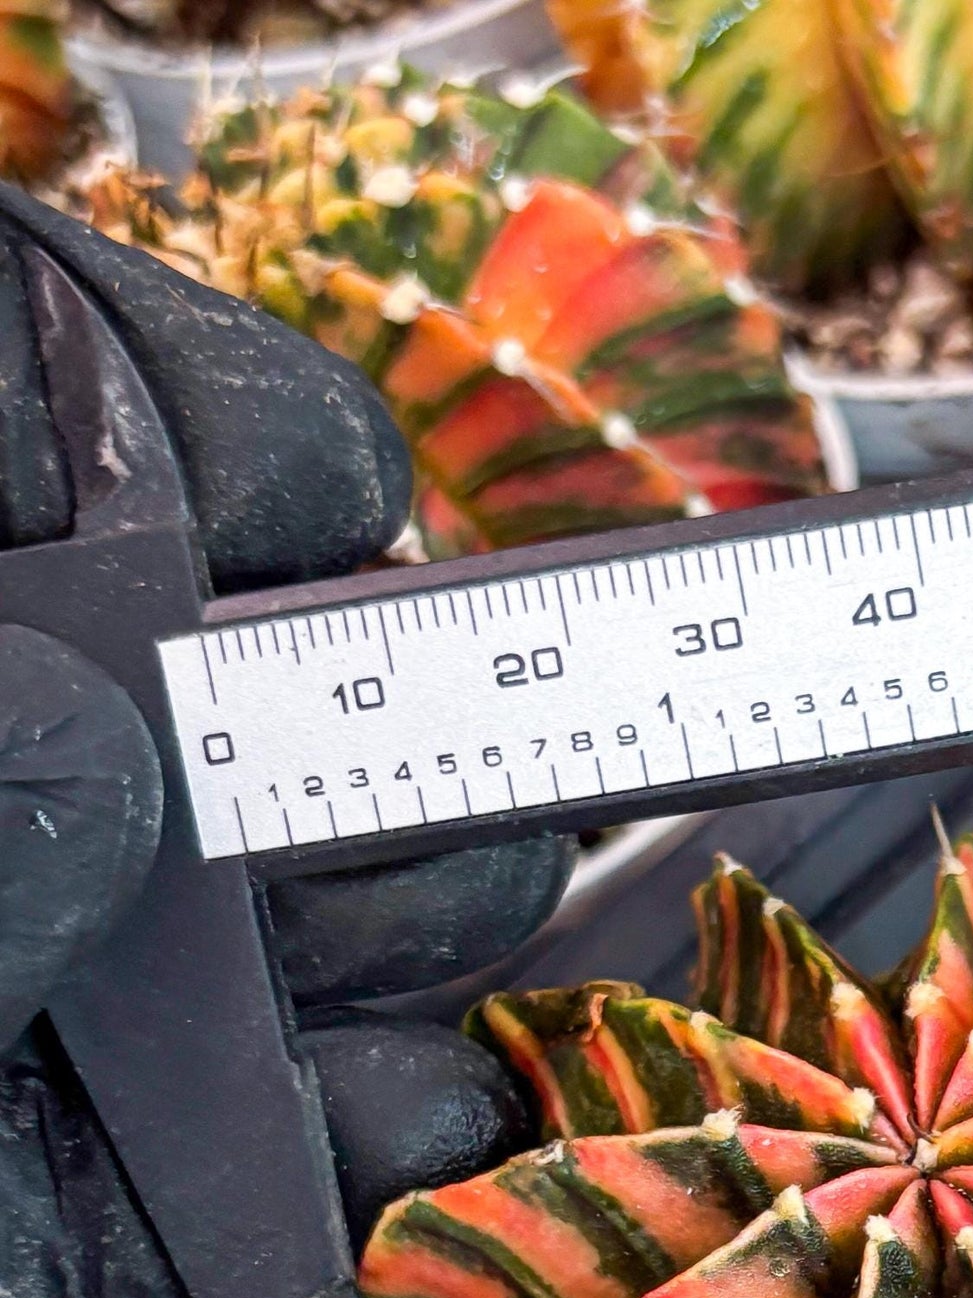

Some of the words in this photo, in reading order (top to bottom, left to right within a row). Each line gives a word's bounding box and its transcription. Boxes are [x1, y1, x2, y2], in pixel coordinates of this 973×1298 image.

[203, 732, 234, 765] 0
[333, 677, 385, 714] 10
[494, 647, 564, 687] 20
[673, 617, 742, 656] 30
[853, 587, 917, 626] 40
[268, 783, 279, 801] 1
[304, 777, 326, 796] 2
[348, 769, 370, 788] 3
[395, 761, 412, 781] 4
[438, 754, 456, 774] 5
[483, 746, 502, 766] 6
[531, 739, 546, 759] 7
[571, 731, 593, 752] 8
[617, 724, 637, 745] 9
[658, 692, 674, 723] 1
[716, 710, 725, 728] 1
[751, 702, 770, 722] 2
[795, 694, 815, 713] 3
[842, 686, 857, 707] 4
[884, 679, 902, 699] 5
[928, 671, 948, 692] 6
